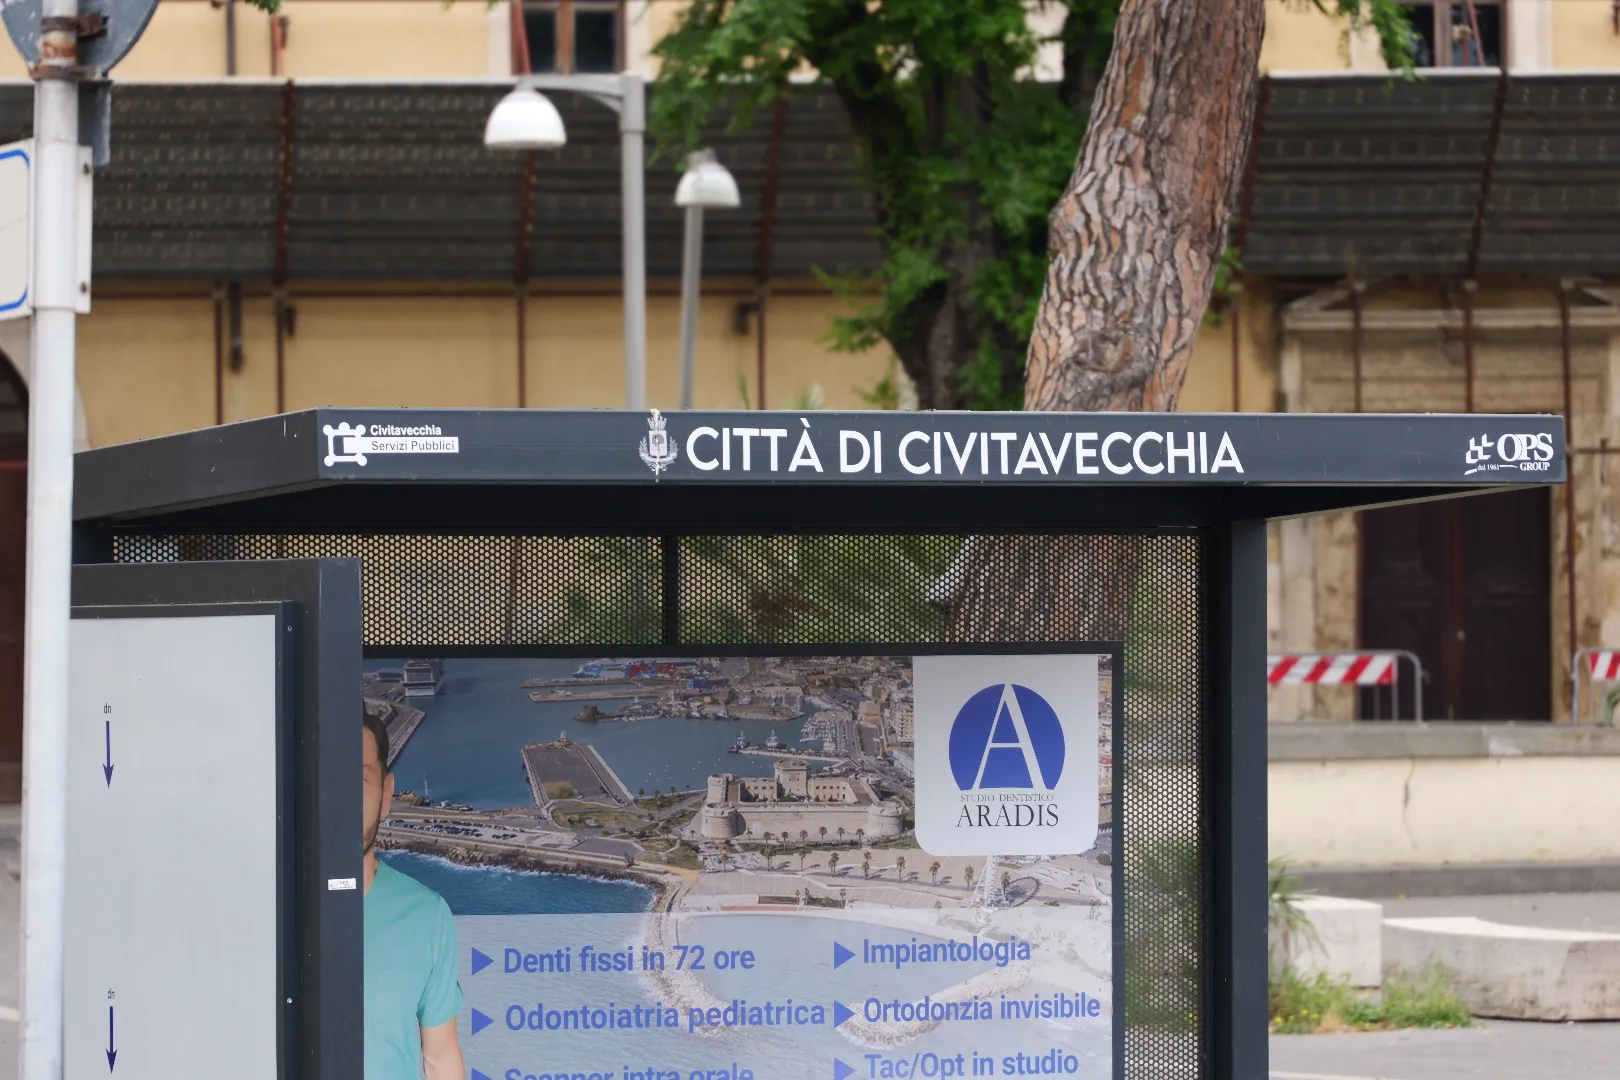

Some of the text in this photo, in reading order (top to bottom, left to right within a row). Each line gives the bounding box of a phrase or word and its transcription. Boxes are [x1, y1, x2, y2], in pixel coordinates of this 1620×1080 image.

[370, 424, 442, 436] Civitavecchia
[371, 440, 455, 451] Servizi Pubblici
[686, 417, 1245, 475] CITTÀ DI CIVITAVECCHIA
[1497, 432, 1554, 462] OPS
[1487, 463, 1500, 471] 1961
[1519, 461, 1551, 471] GROUP
[960, 793, 1055, 802] STUDIO DENTISTICO
[955, 803, 1059, 828] ARADIS
[504, 945, 756, 973] Denti fissi in 72 ore
[863, 935, 1031, 970] Impiantologia
[505, 998, 825, 1033] Odontoiatria pediatrica
[864, 992, 1101, 1022] Ortodonzia invisibile
[864, 1048, 1079, 1080] Tac/Opt in studio
